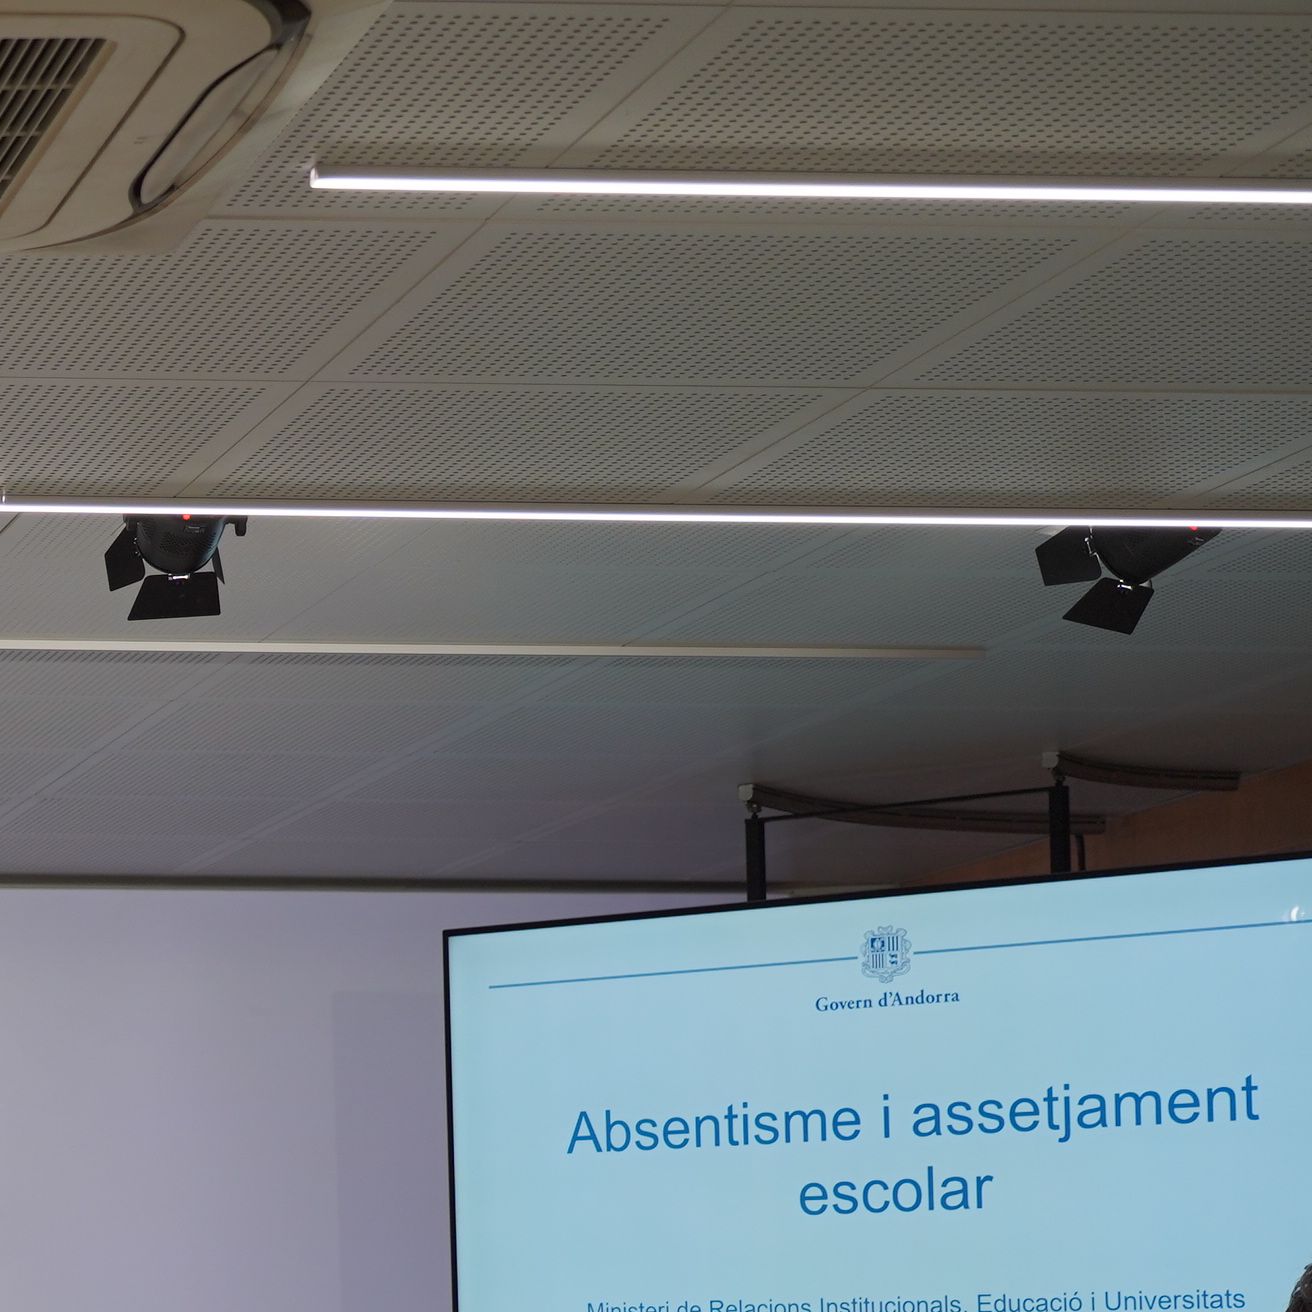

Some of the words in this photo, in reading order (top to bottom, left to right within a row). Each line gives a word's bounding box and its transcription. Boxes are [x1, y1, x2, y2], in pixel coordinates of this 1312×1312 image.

[815, 997, 873, 1012] Govern
[878, 989, 960, 1008] d’Andorra
[566, 1101, 861, 1155] Absentisme
[882, 1093, 891, 1139] i
[912, 1074, 1260, 1144] assetjament
[799, 1165, 994, 1216] escolar
[1104, 1289, 1246, 1312] Universitats
